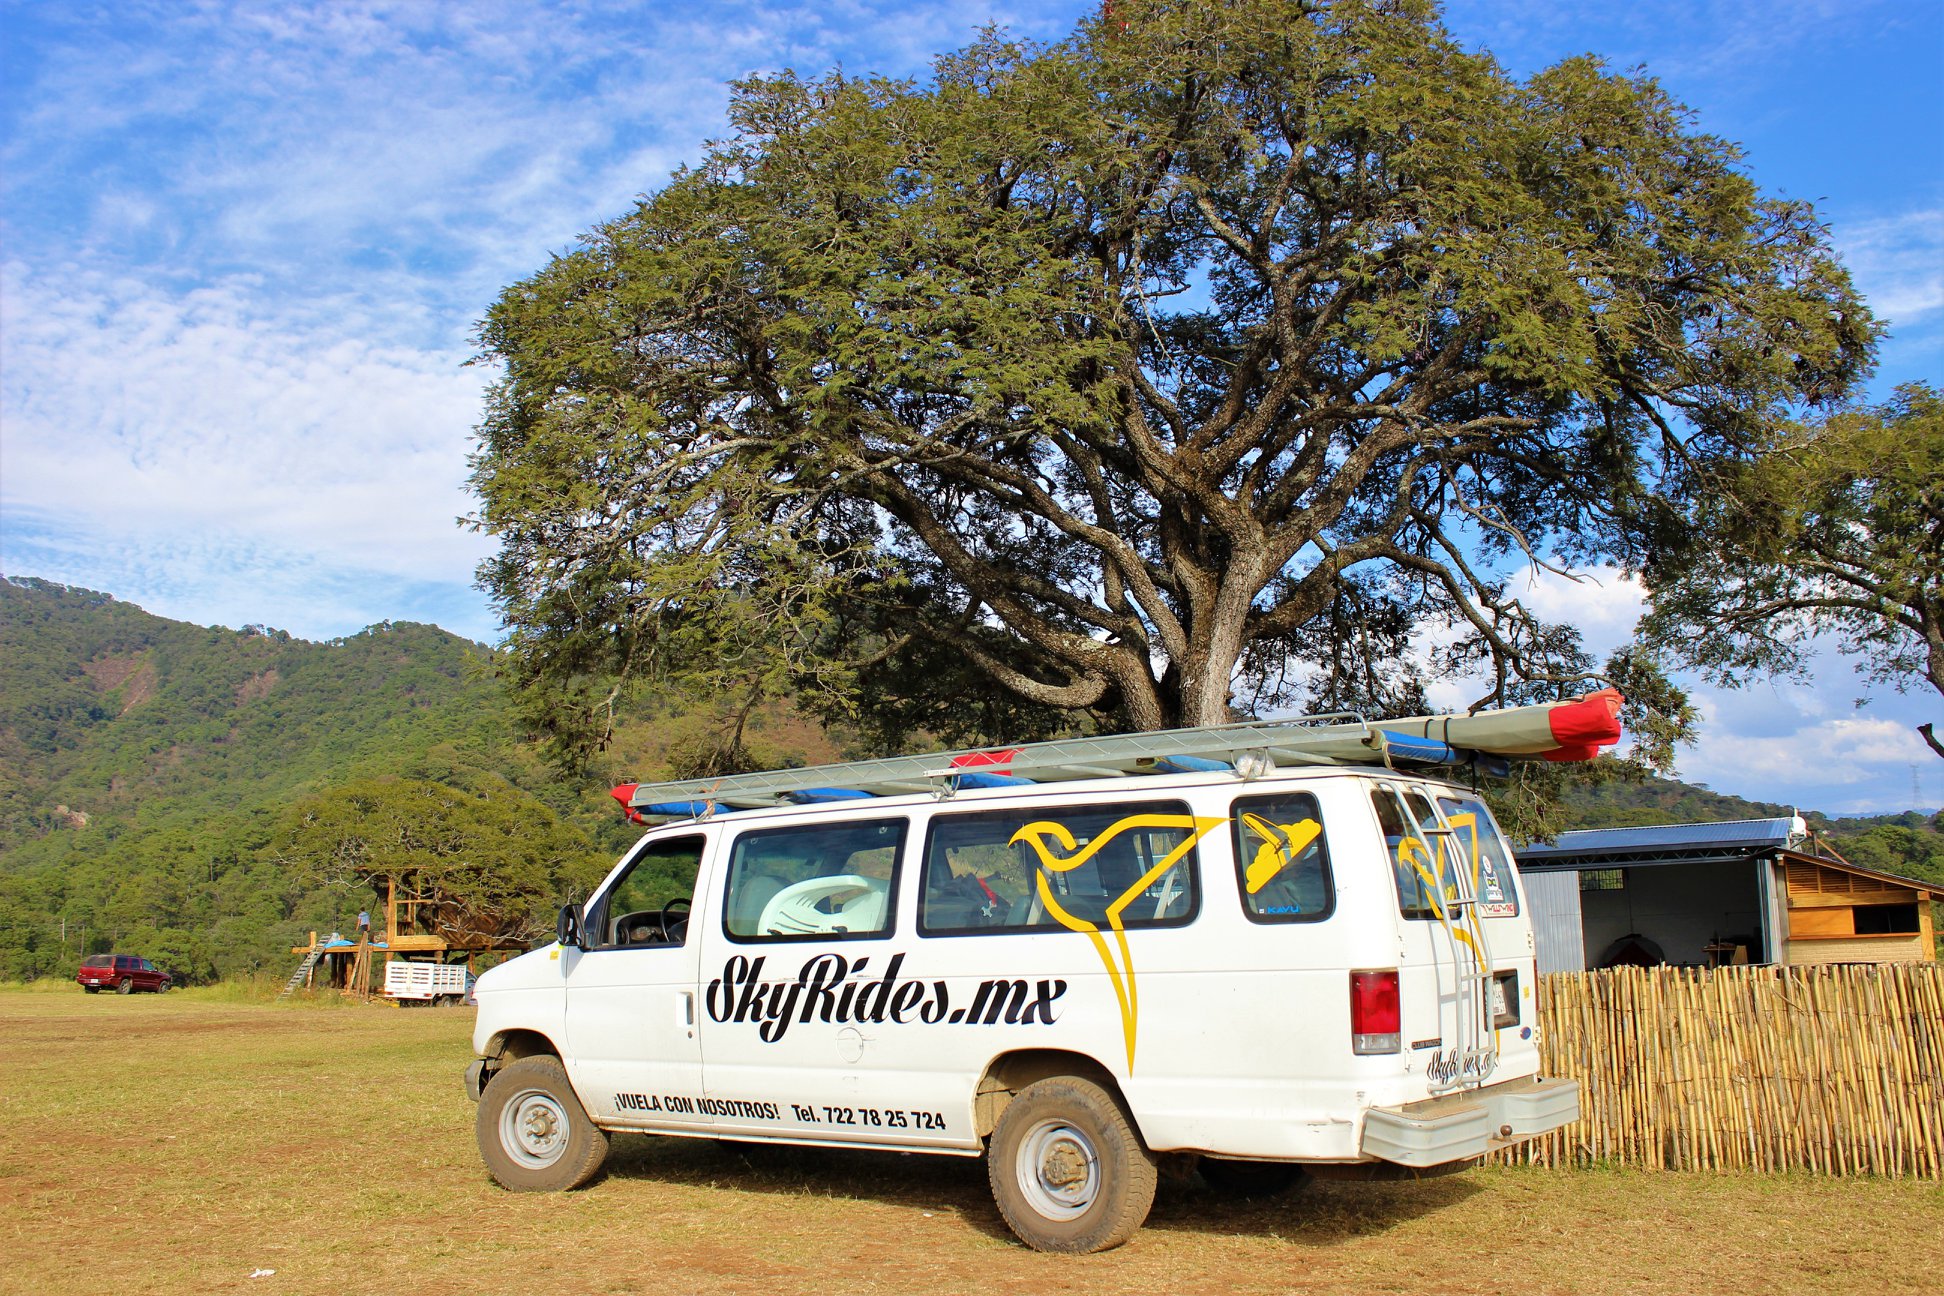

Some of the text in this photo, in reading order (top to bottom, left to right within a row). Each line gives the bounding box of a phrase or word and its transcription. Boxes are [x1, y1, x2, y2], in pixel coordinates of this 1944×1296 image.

[1267, 905, 1300, 914] KAVU
[706, 952, 1068, 1043] SkyRides.mx
[614, 1092, 947, 1131] ¡VUELA CON NOSOTROS! Tel. 722 78 25 724
